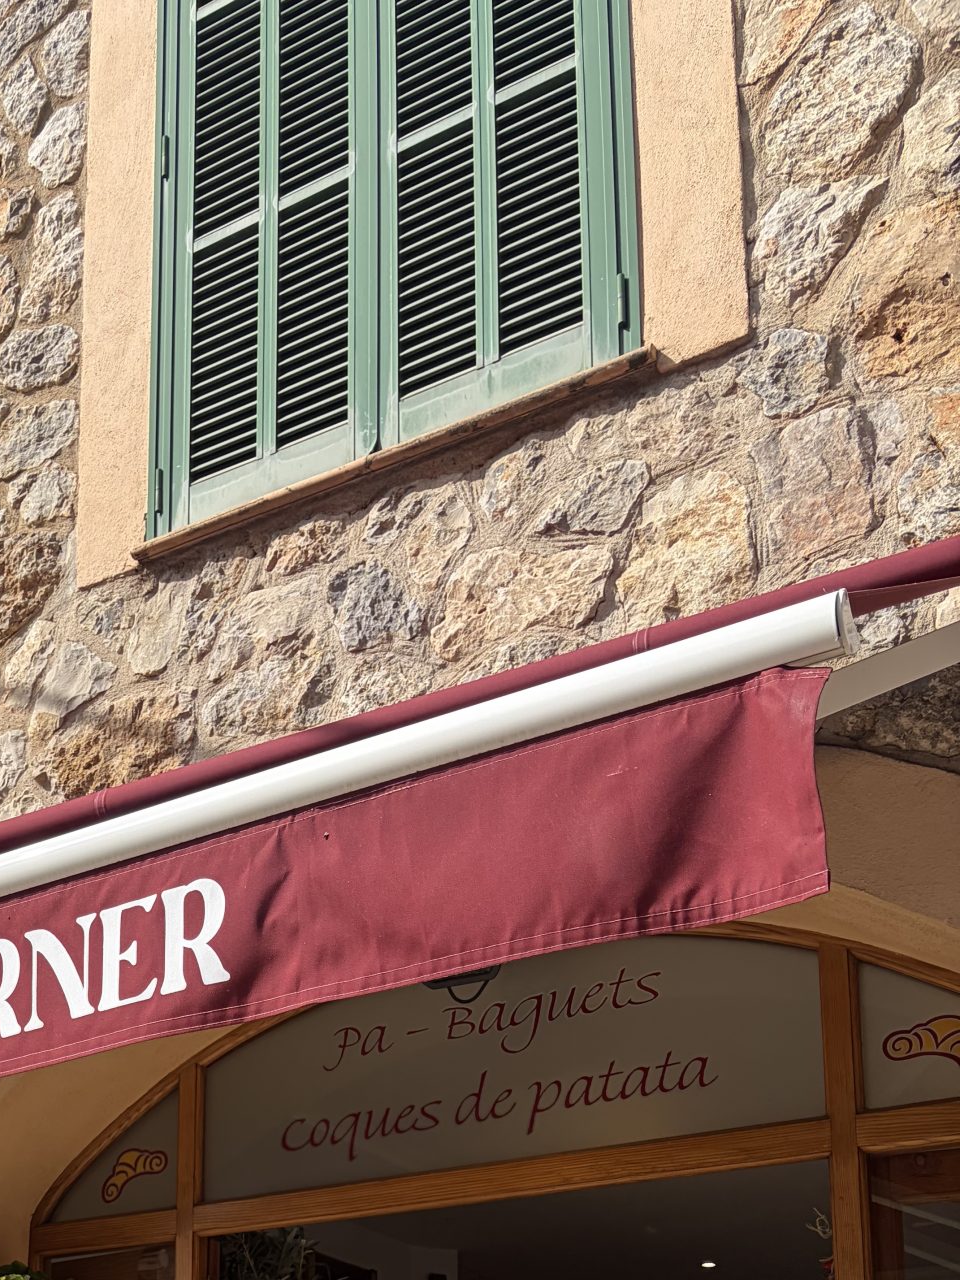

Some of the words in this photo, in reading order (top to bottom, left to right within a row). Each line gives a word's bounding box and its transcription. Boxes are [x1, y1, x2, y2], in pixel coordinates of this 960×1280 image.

[323, 1025, 394, 1072] Pa
[442, 967, 662, 1054] Baguets
[281, 1099, 443, 1161] coques
[454, 1070, 517, 1122] de
[527, 1050, 720, 1135] patata
